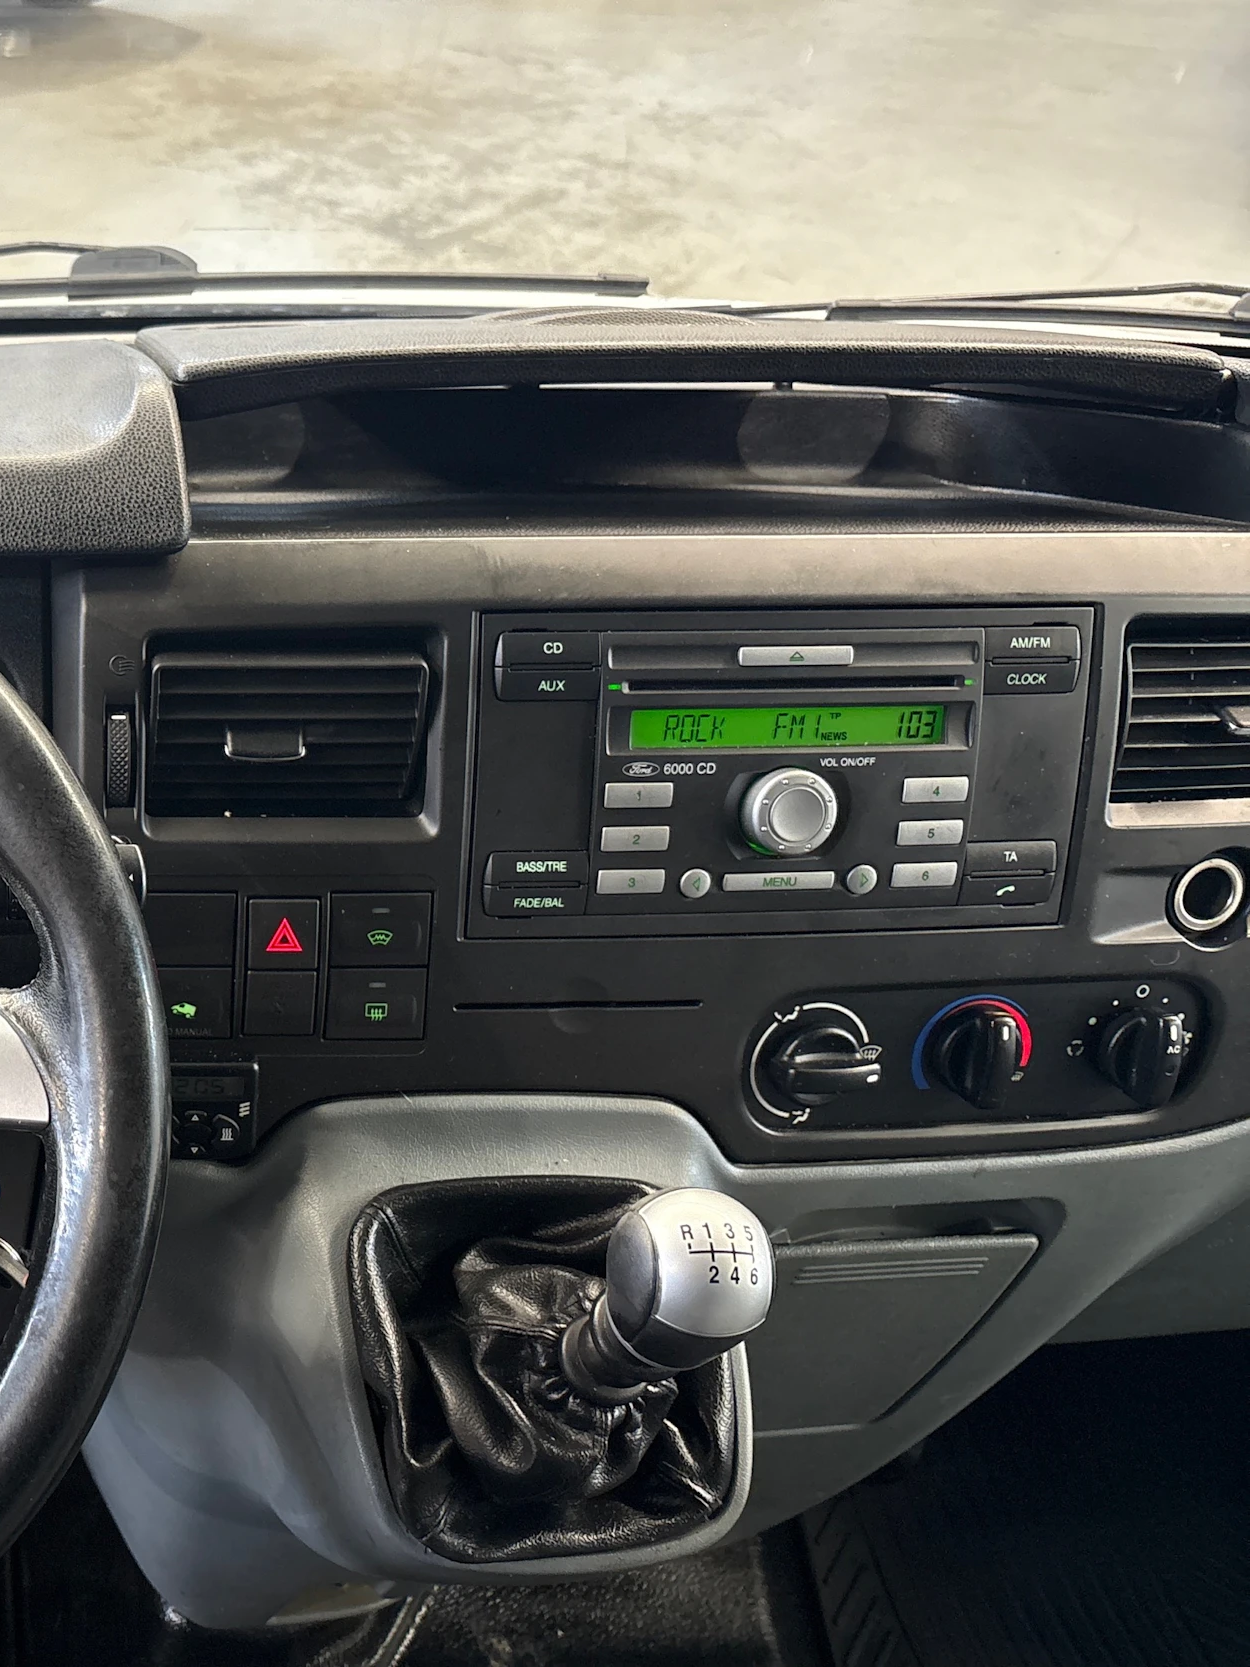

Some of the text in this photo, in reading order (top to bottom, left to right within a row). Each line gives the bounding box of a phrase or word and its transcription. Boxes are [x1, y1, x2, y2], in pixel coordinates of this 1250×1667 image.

[543, 643, 563, 654] CD
[1010, 637, 1051, 649] AM/FM
[1007, 673, 1047, 685] CLOCK
[538, 680, 565, 692] AUX
[663, 711, 937, 742] ROCK FM1 103
[820, 732, 847, 741] NEWS
[820, 757, 877, 767] VOL ON/OFF
[663, 763, 694, 775] 6000
[696, 762, 717, 775] CD
[635, 790, 642, 801] 1
[932, 786, 940, 797] 4
[927, 828, 935, 838] 5
[632, 834, 641, 845] 2
[1003, 851, 1018, 862] TA
[516, 861, 568, 873] BASS/TRE
[922, 870, 929, 881] 6
[628, 877, 636, 888] 3
[762, 876, 797, 887] MENU
[513, 897, 564, 909] FADE/BAL
[1166, 1045, 1182, 1055] AC
[680, 1222, 753, 1241] R 1 3 5
[709, 1266, 759, 1285] 2 4 6
